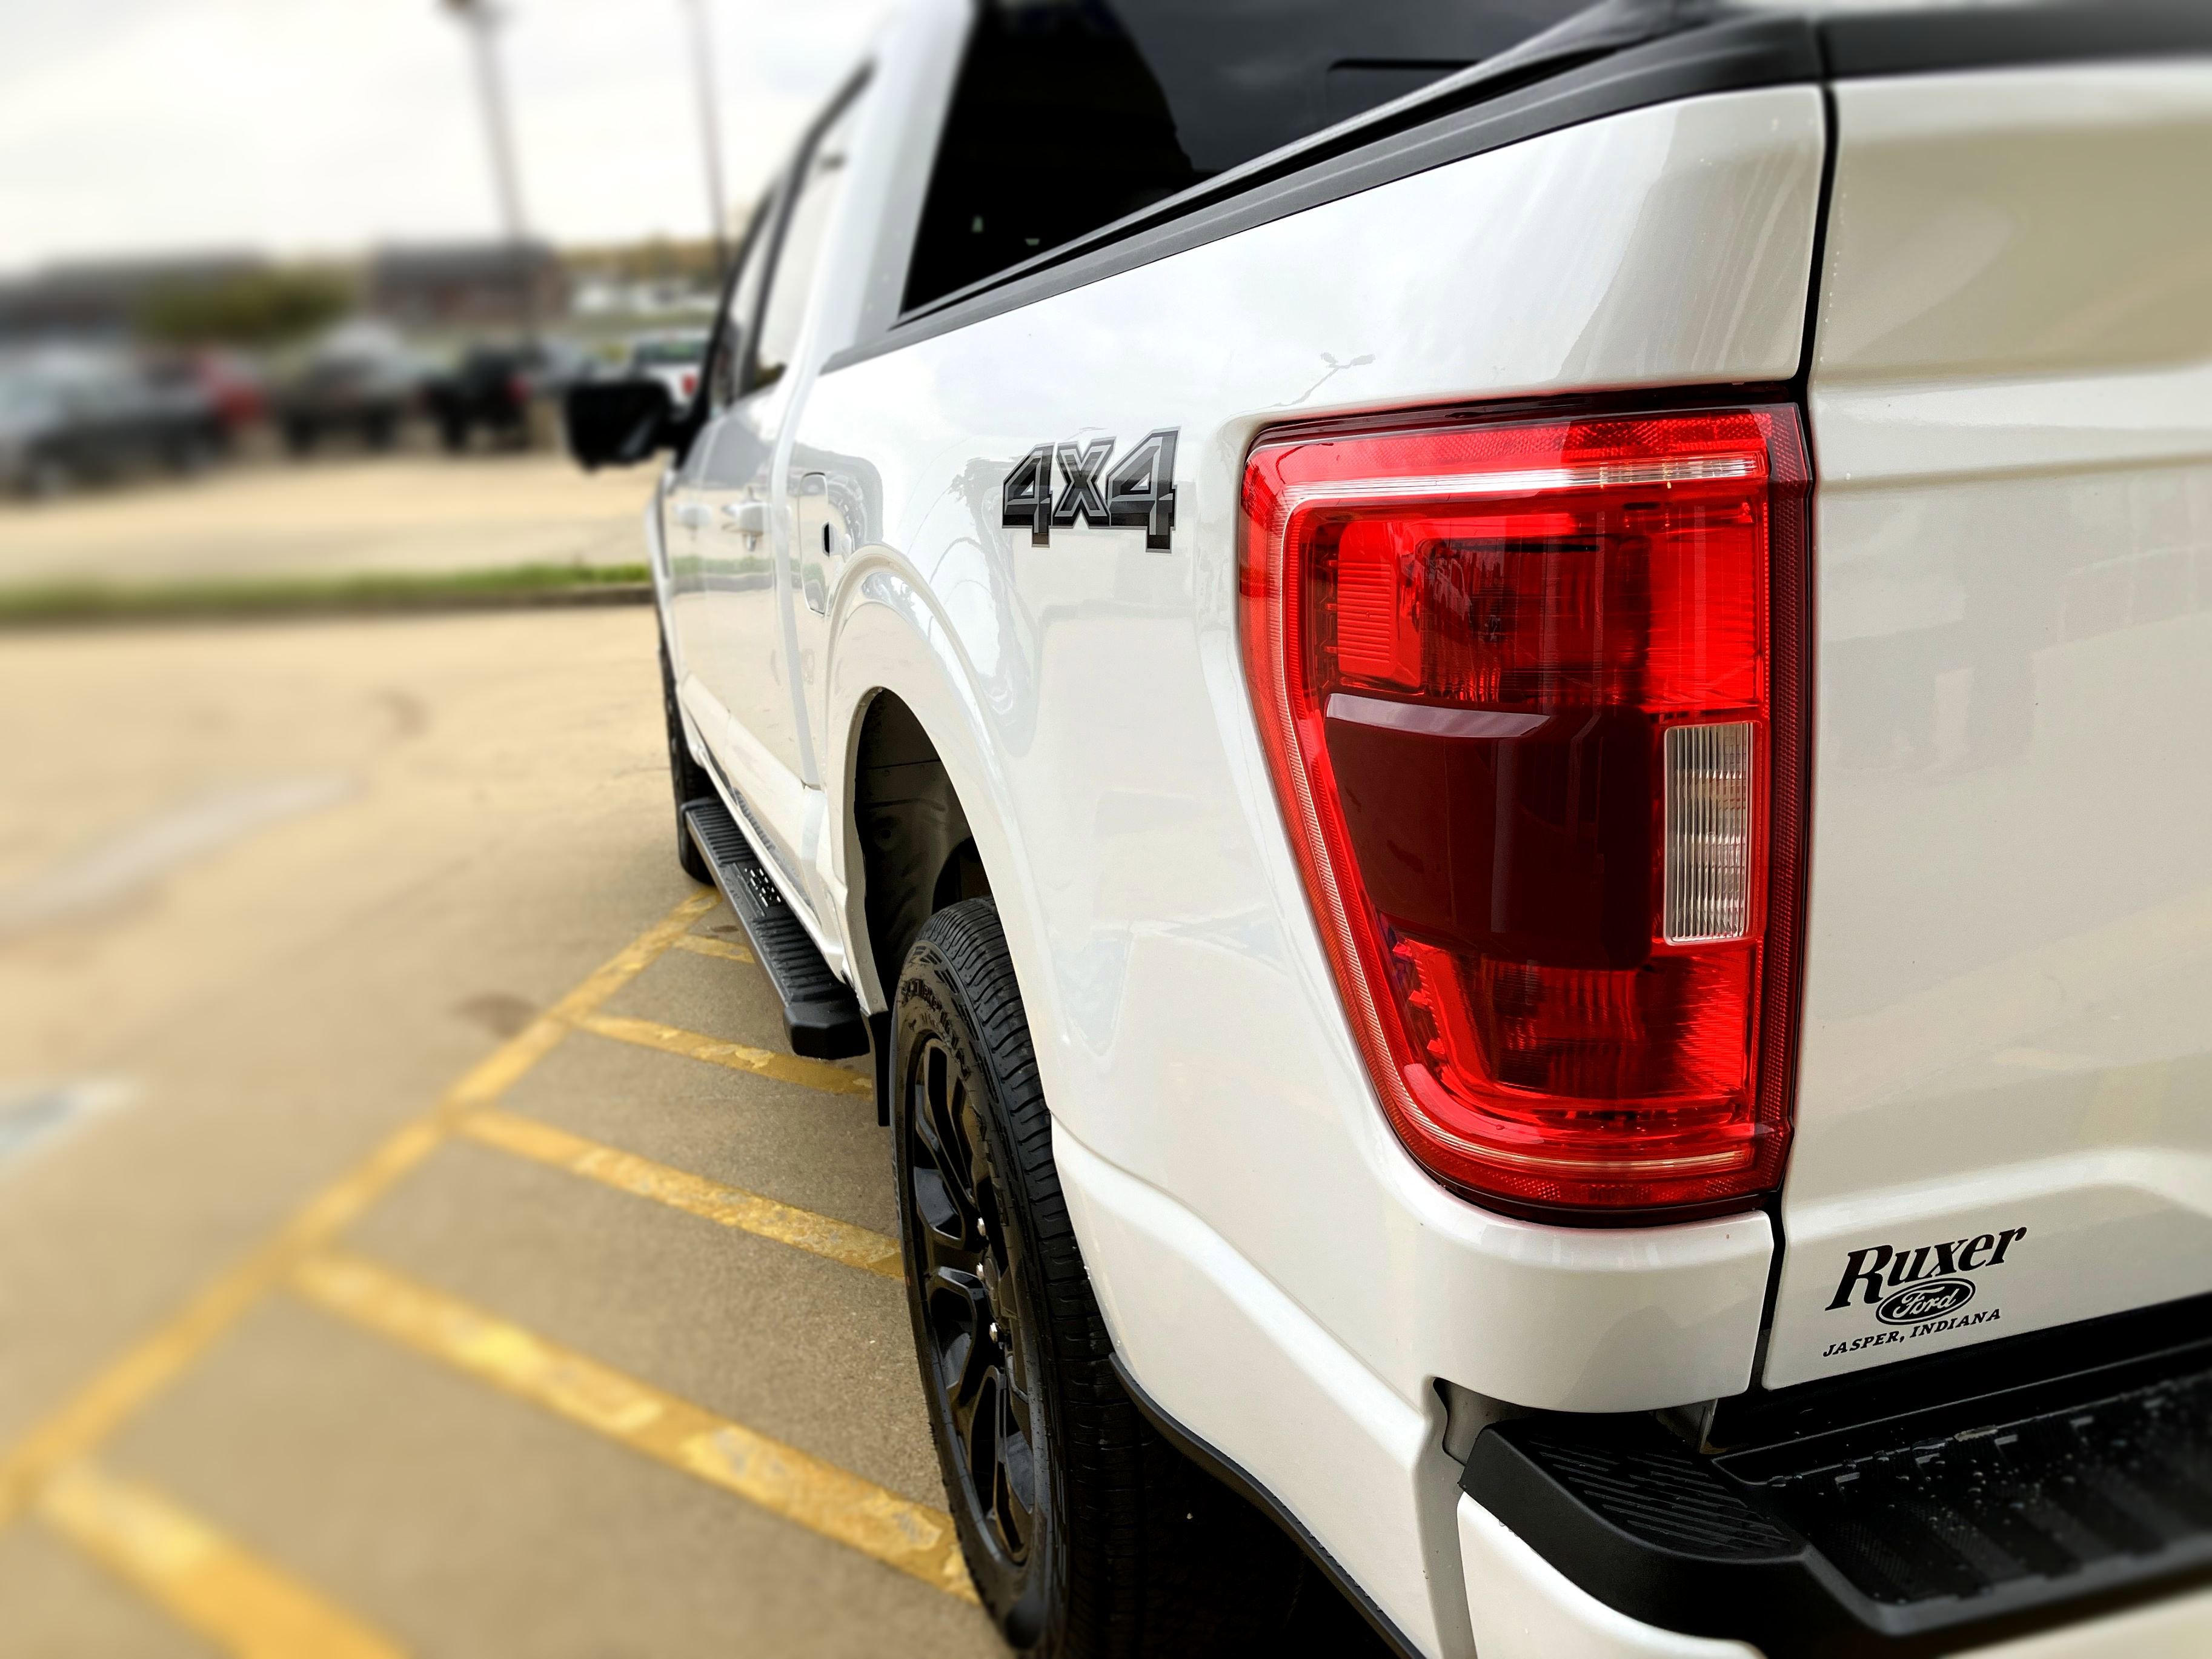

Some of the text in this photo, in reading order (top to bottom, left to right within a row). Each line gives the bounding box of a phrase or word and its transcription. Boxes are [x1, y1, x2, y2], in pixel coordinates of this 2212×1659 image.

[1824, 1226, 2027, 1311] Ruxer
[1892, 1286, 1960, 1318] Ford
[1822, 1308, 2001, 1357] JASPER, INDIANA
